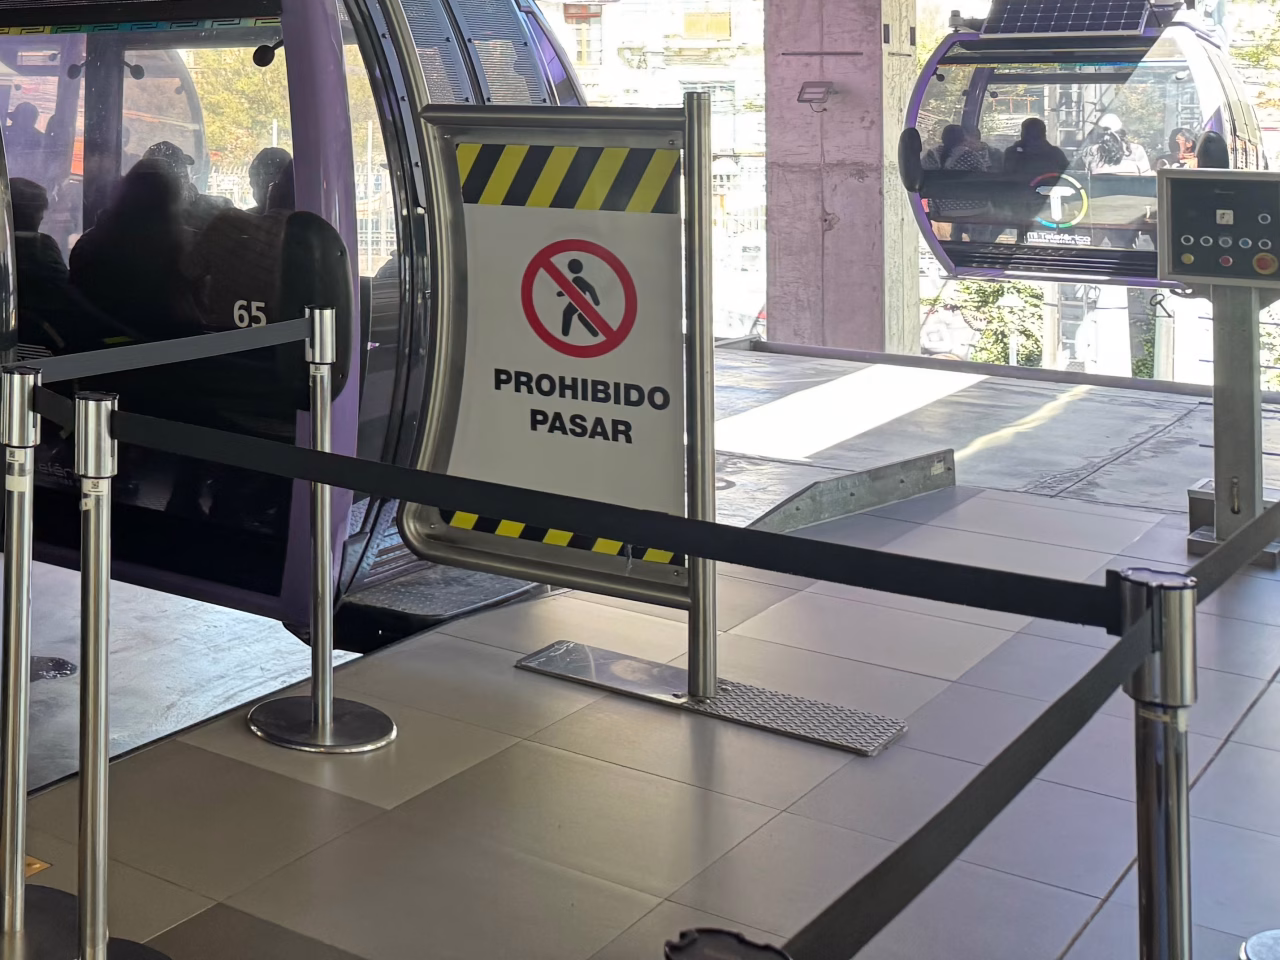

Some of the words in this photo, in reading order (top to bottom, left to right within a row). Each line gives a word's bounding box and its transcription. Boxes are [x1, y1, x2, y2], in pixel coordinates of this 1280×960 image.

[233, 299, 267, 328] 65
[494, 367, 671, 411] PROHIBIDO
[530, 408, 633, 444] PASAR
